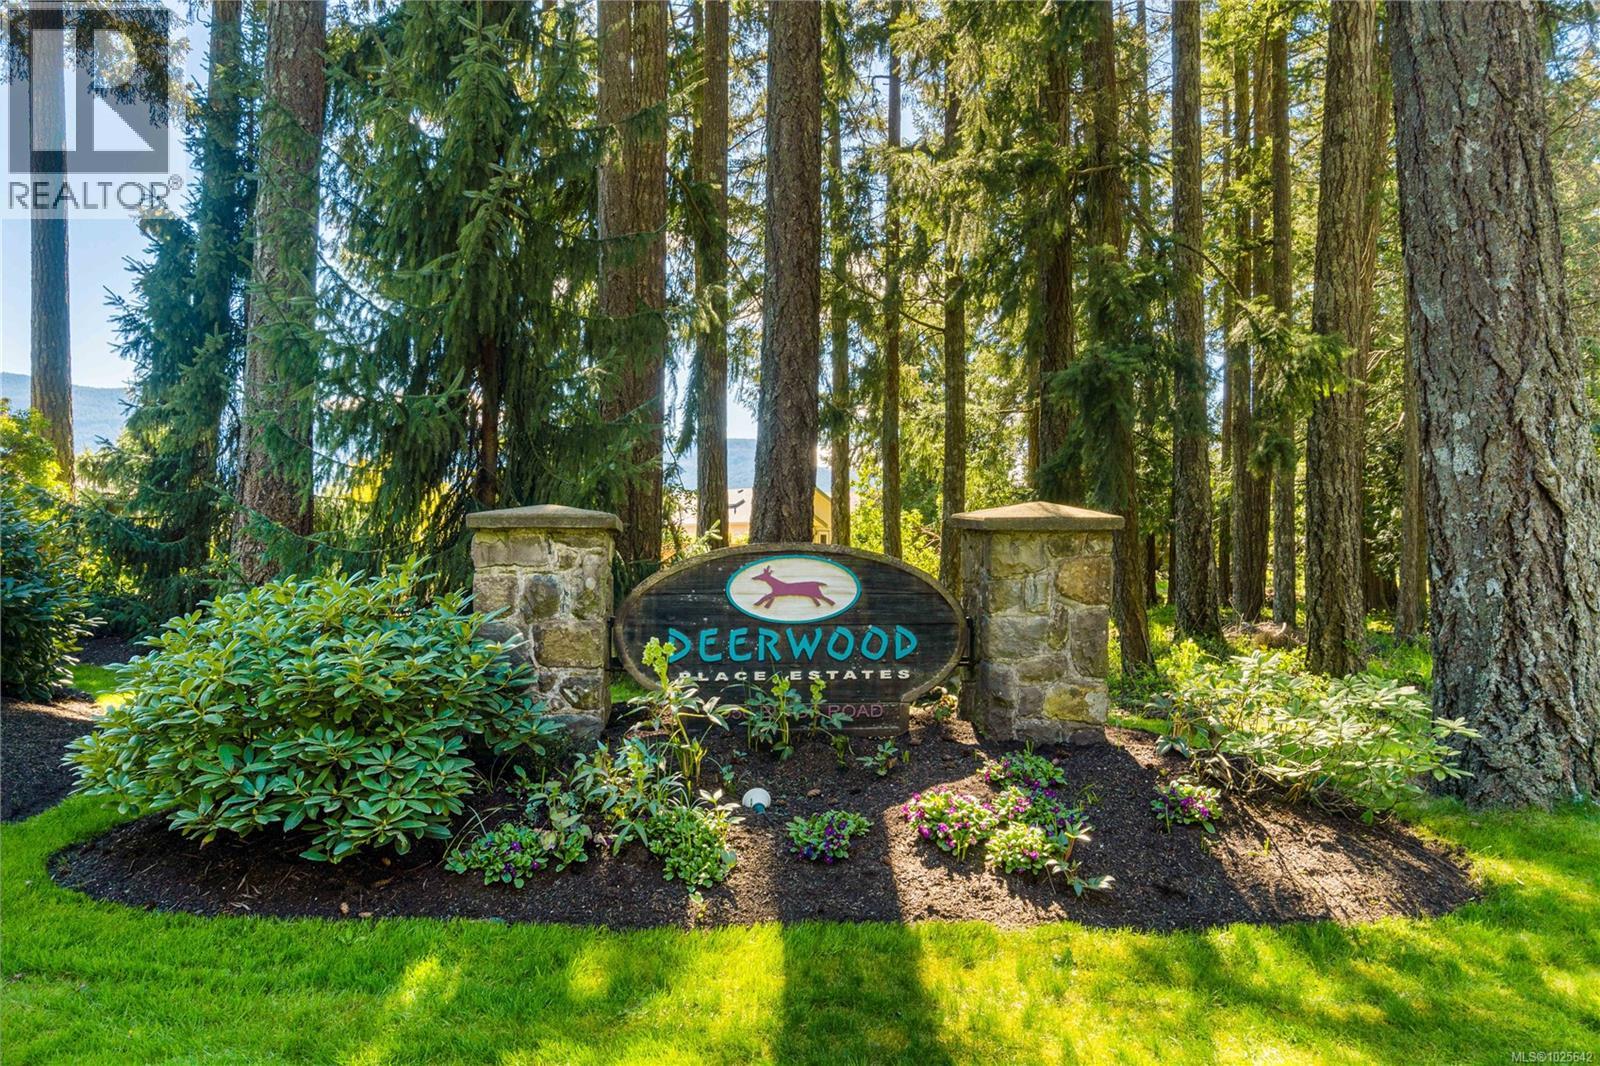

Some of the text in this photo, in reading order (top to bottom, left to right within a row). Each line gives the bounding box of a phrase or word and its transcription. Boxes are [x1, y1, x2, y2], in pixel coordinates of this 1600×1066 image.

[668, 625, 918, 664] DEERWOOD
[678, 669, 910, 682] PLACE ESTATES
[828, 704, 883, 718] ROAD
